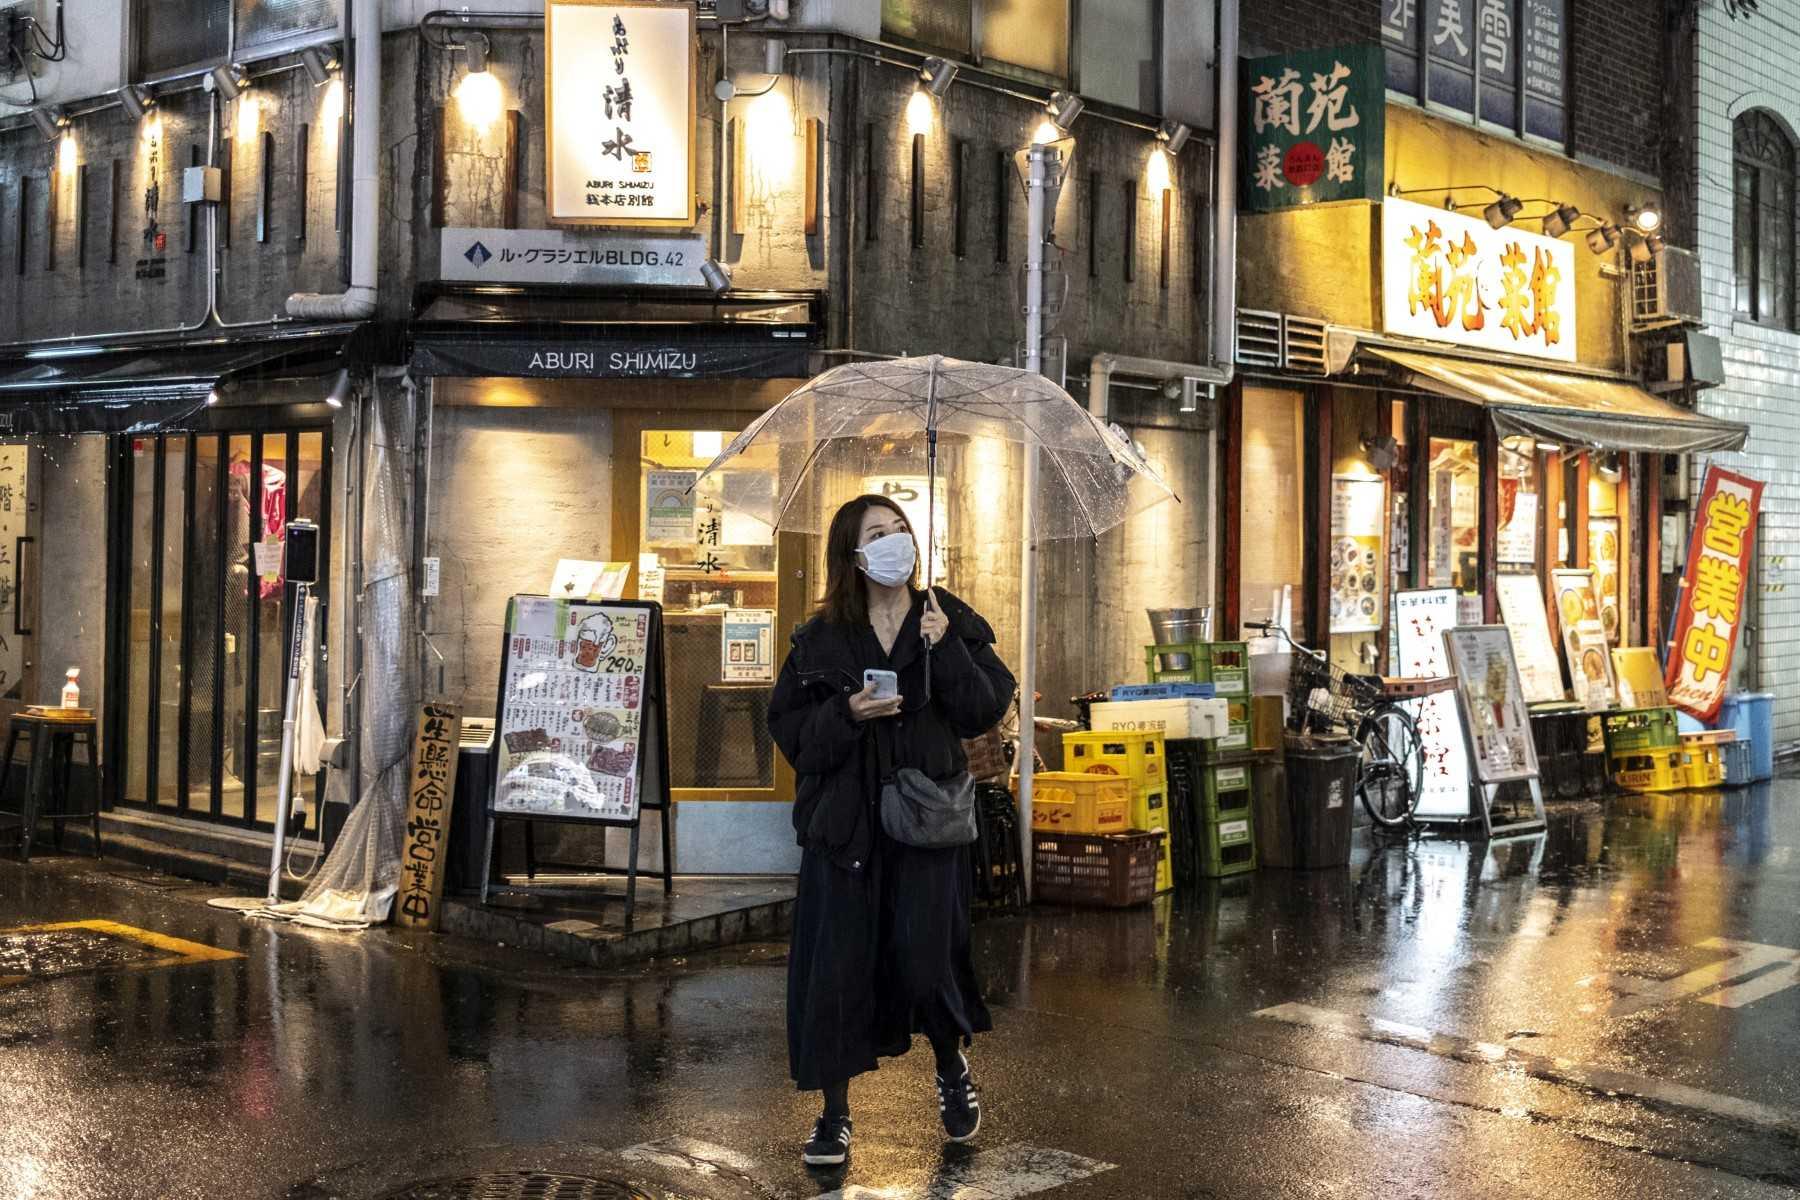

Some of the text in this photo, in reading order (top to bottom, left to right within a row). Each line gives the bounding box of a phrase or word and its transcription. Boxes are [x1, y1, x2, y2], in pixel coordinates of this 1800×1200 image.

[1389, 0, 1416, 28] 2F
[601, 12, 638, 162] あぶり清水
[1251, 60, 1360, 136] 蘭苑
[586, 180, 654, 190] ABURI SHIMIZU
[528, 352, 697, 370] ABURI SHIMIZU
[1684, 490, 1752, 683] 営業中
[1619, 773, 1651, 785] KIRIN
